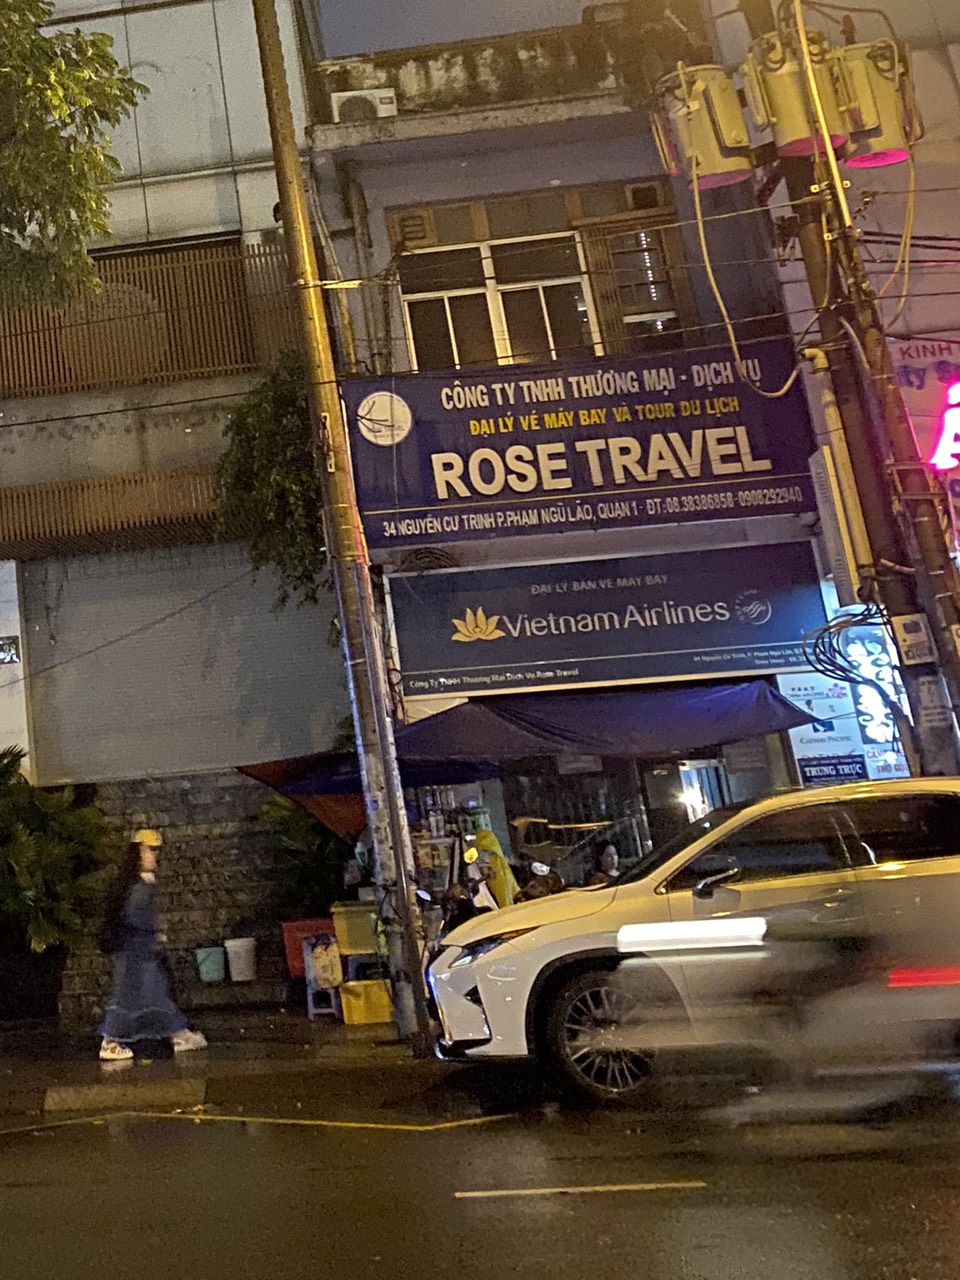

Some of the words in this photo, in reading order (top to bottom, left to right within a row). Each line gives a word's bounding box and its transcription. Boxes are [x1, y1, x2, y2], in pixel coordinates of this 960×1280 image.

[441, 380, 490, 411] CÔNG
[491, 382, 515, 407] TY
[519, 377, 566, 403] TNHH
[568, 370, 640, 399] THƯƠNG
[642, 367, 676, 396] MẠI
[691, 361, 735, 392] DỊCH
[469, 419, 496, 438] ĐẠI
[498, 412, 516, 433] LÝ
[519, 410, 541, 431] VÉ
[543, 407, 575, 429] MÁY
[578, 408, 607, 426] BAY
[612, 402, 632, 423] VÀ
[635, 402, 676, 420] TOUR
[680, 400, 701, 417] DU
[705, 395, 740, 418] LỊCH
[430, 441, 573, 500] ROSE
[576, 425, 773, 487] TRAVEL
[383, 521, 397, 537] 34
[461, 513, 496, 530] TRINH
[645, 573, 668, 585] BAY
[503, 611, 620, 639] Vietnam
[623, 600, 730, 628] Airlines
